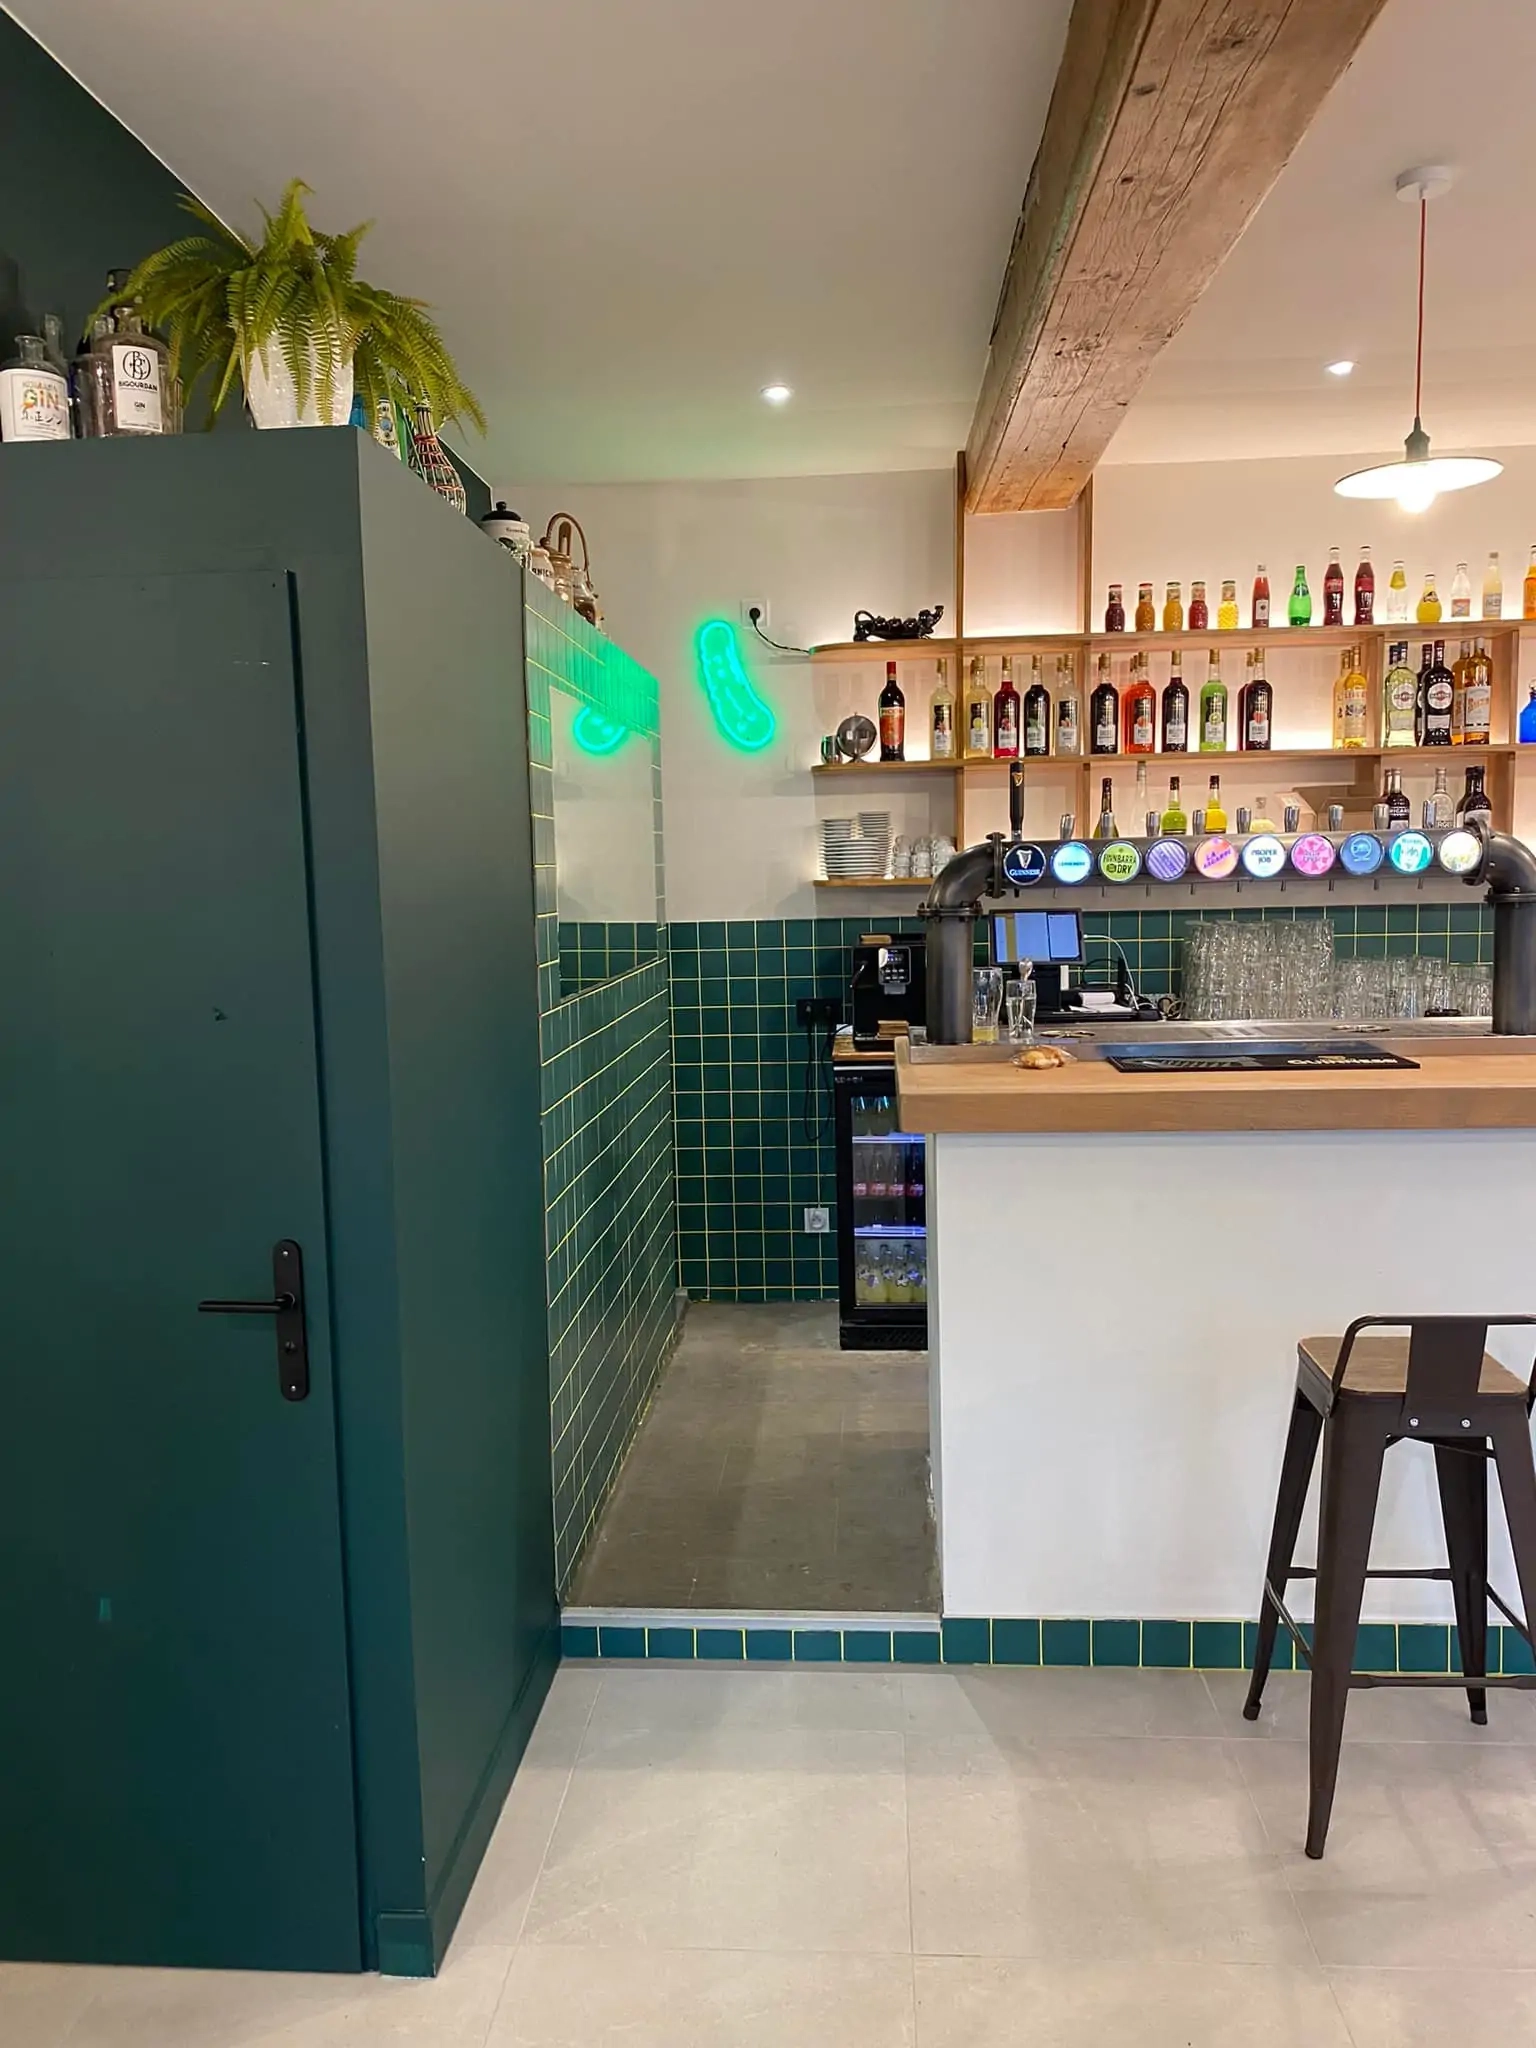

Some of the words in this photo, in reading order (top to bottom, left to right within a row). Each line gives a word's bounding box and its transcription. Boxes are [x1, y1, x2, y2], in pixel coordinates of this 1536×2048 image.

[118, 381, 158, 391] BIGOURDAN
[134, 401, 146, 409] GIN
[1116, 864, 1133, 874] DRY
